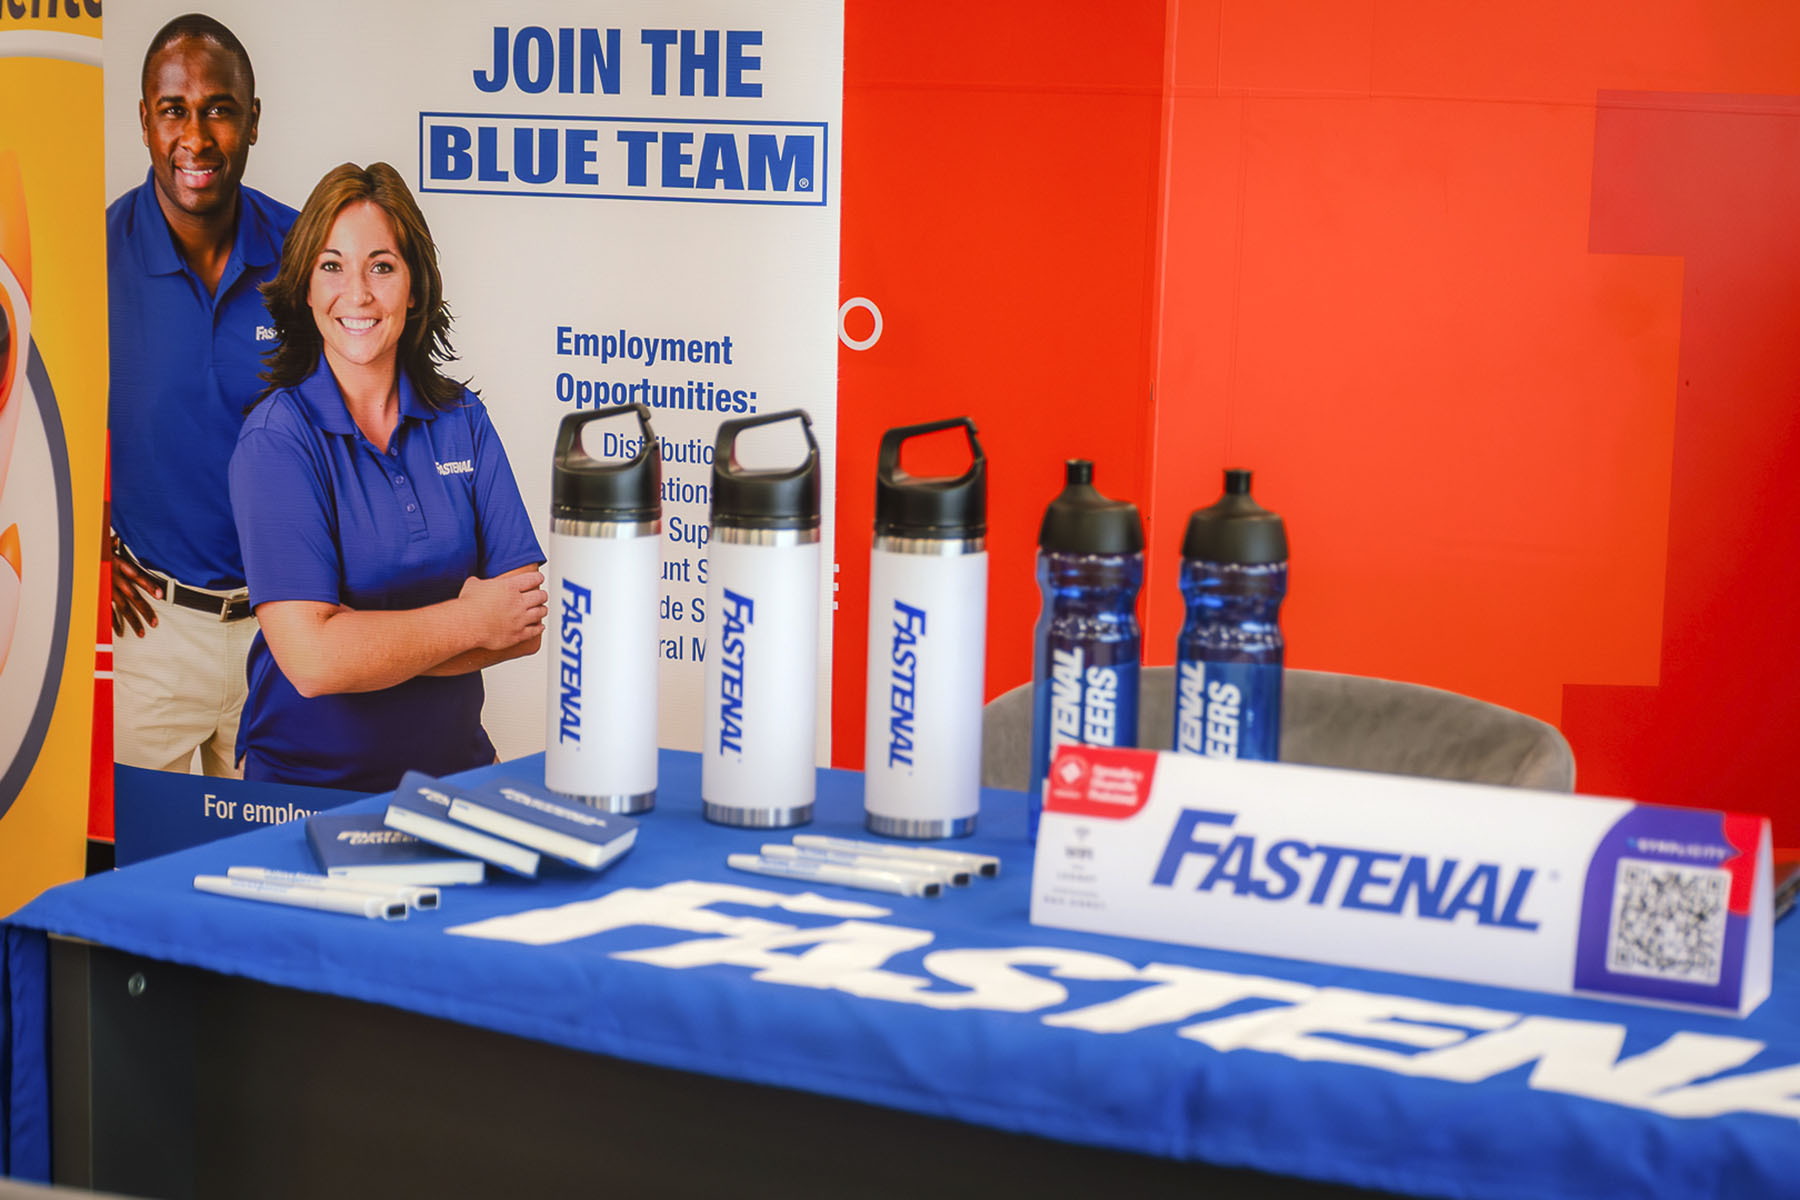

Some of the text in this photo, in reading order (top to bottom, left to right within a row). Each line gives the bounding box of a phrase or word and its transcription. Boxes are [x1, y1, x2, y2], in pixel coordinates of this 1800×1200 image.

[473, 26, 763, 98] JOIN THE
[430, 125, 599, 185] BLUE
[556, 326, 733, 366] Employment
[556, 372, 758, 413] Opportunities:
[560, 577, 592, 745] FASTENAL
[720, 587, 755, 756] FASTENAL
[889, 599, 926, 769] FASTENAL
[204, 794, 237, 820] For
[1151, 807, 1541, 933] FASTENAL
